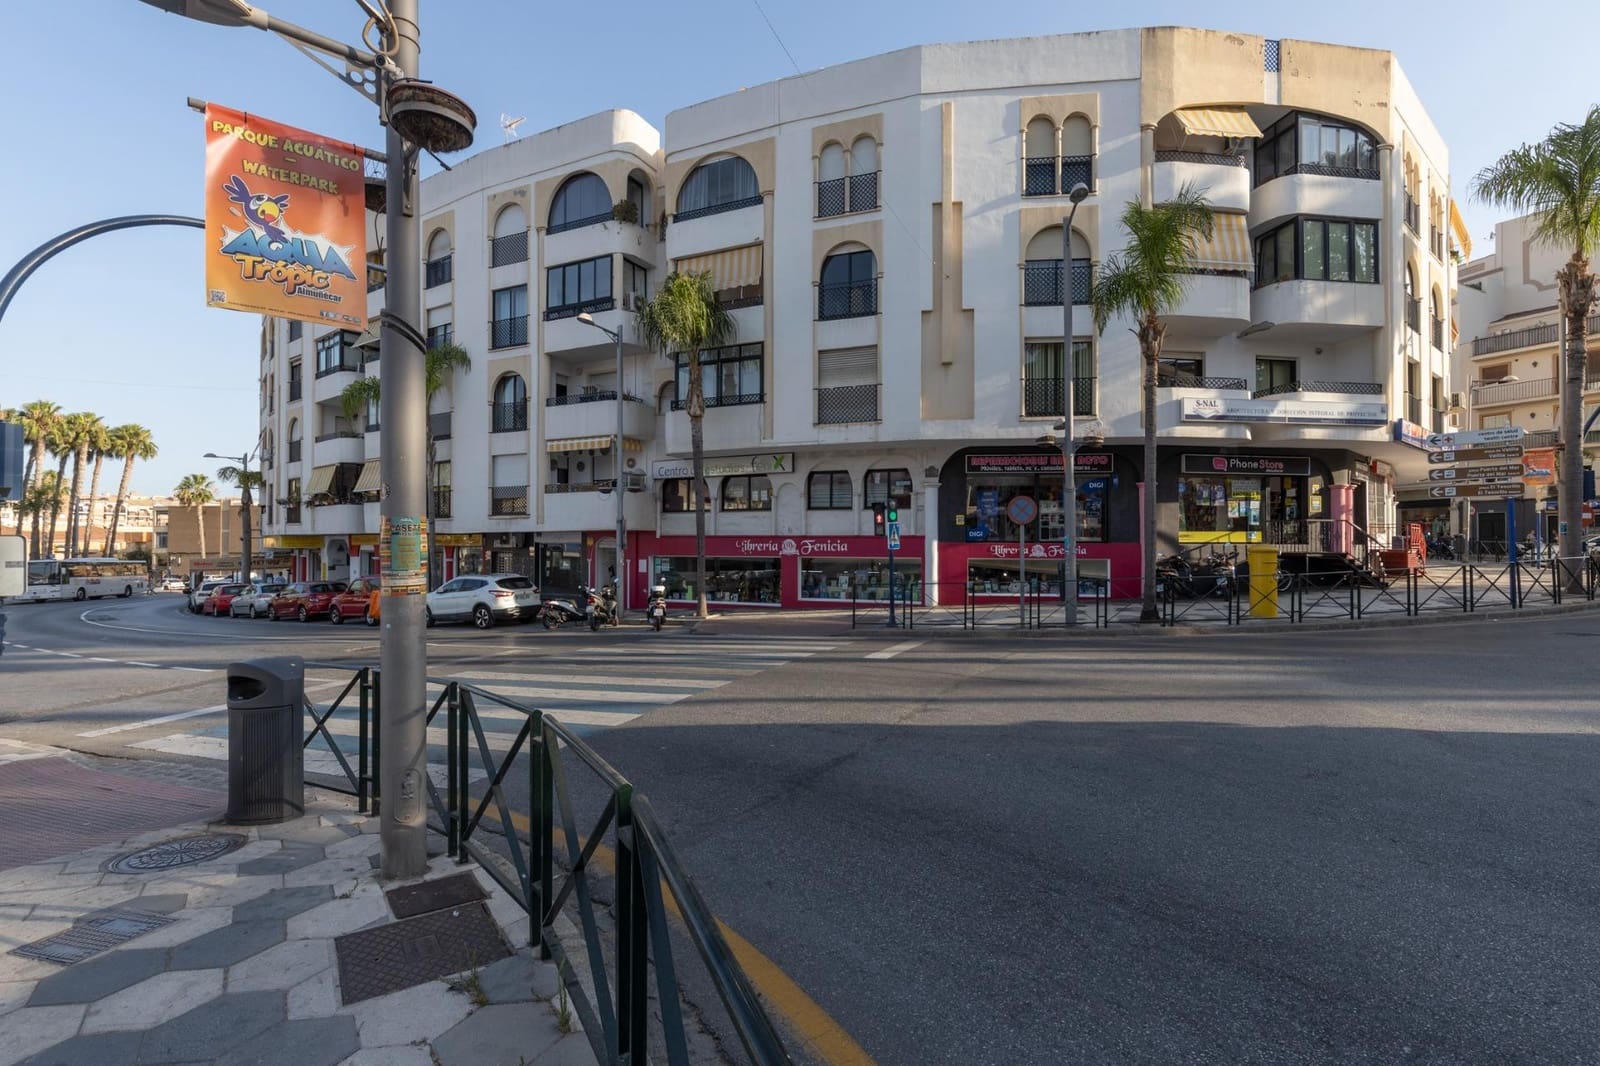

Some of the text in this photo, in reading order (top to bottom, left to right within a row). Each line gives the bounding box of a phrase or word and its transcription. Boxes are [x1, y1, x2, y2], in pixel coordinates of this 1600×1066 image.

[212, 120, 360, 172] PARQUE ACUÁTICO
[242, 159, 338, 194] WATERPARK
[220, 228, 357, 280] AQUA
[236, 253, 330, 295] Trópic
[657, 465, 688, 478] Centro
[1089, 481, 1104, 489] DIGI
[968, 530, 984, 538] DIGI
[736, 539, 848, 555] Librería Fenicia
[990, 545, 1029, 558] Librera
